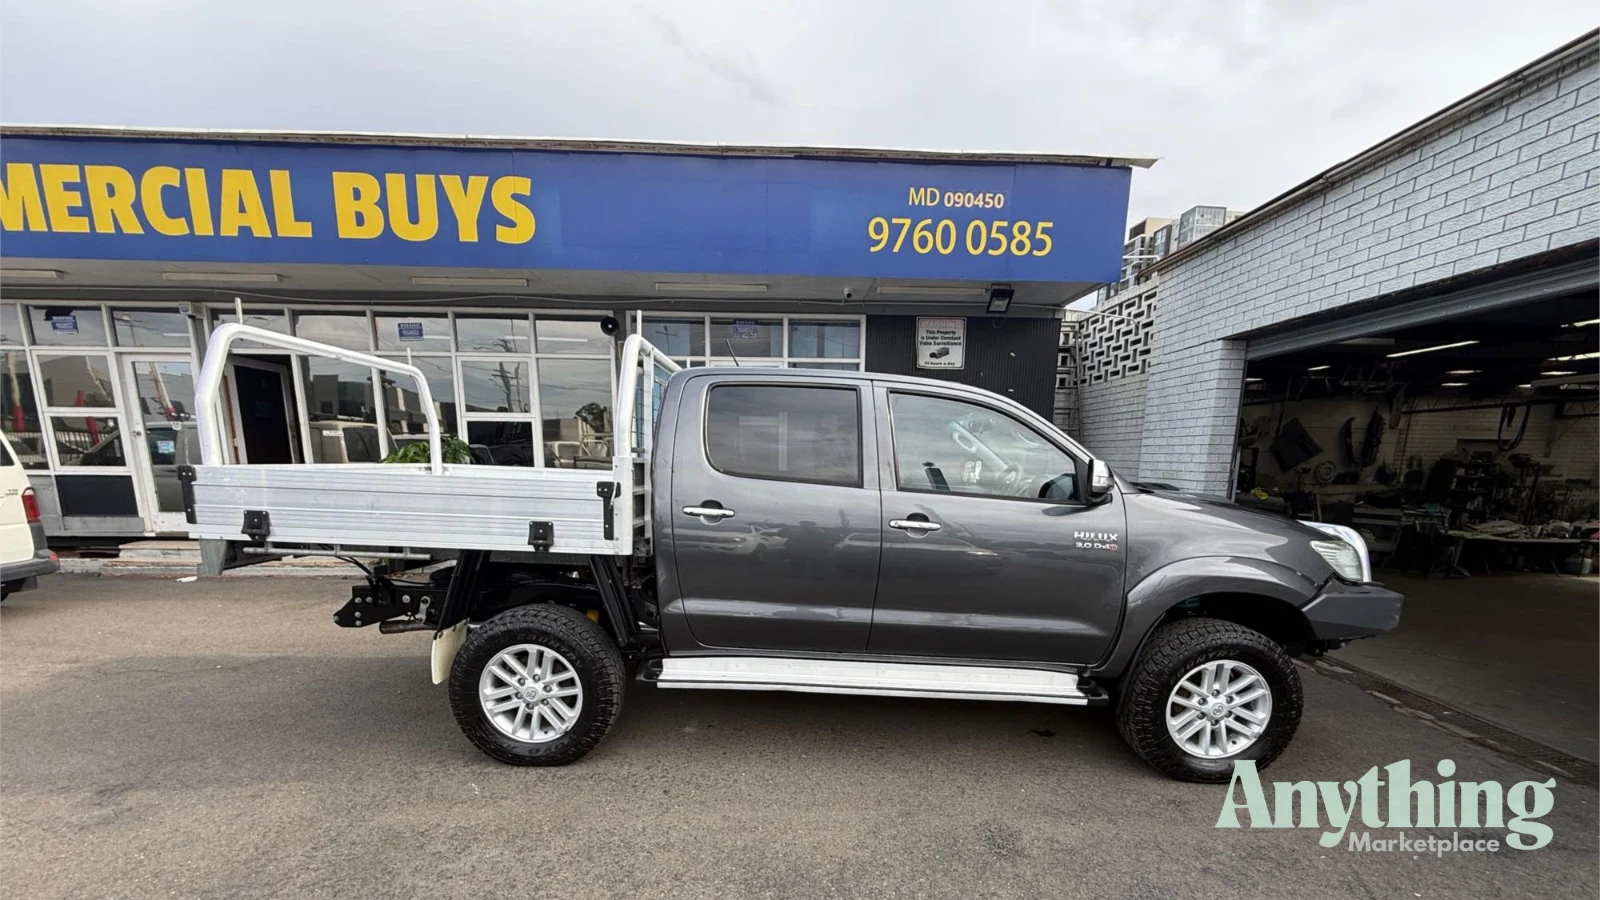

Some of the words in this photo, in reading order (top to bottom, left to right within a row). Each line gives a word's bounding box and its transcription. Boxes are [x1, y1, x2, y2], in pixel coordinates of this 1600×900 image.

[332, 171, 536, 244] BUYS
[908, 187, 940, 206] MD
[944, 192, 1004, 208] 090450
[868, 217, 957, 255] 9760
[965, 220, 1053, 257] 0585
[1073, 531, 1118, 541] HILUX
